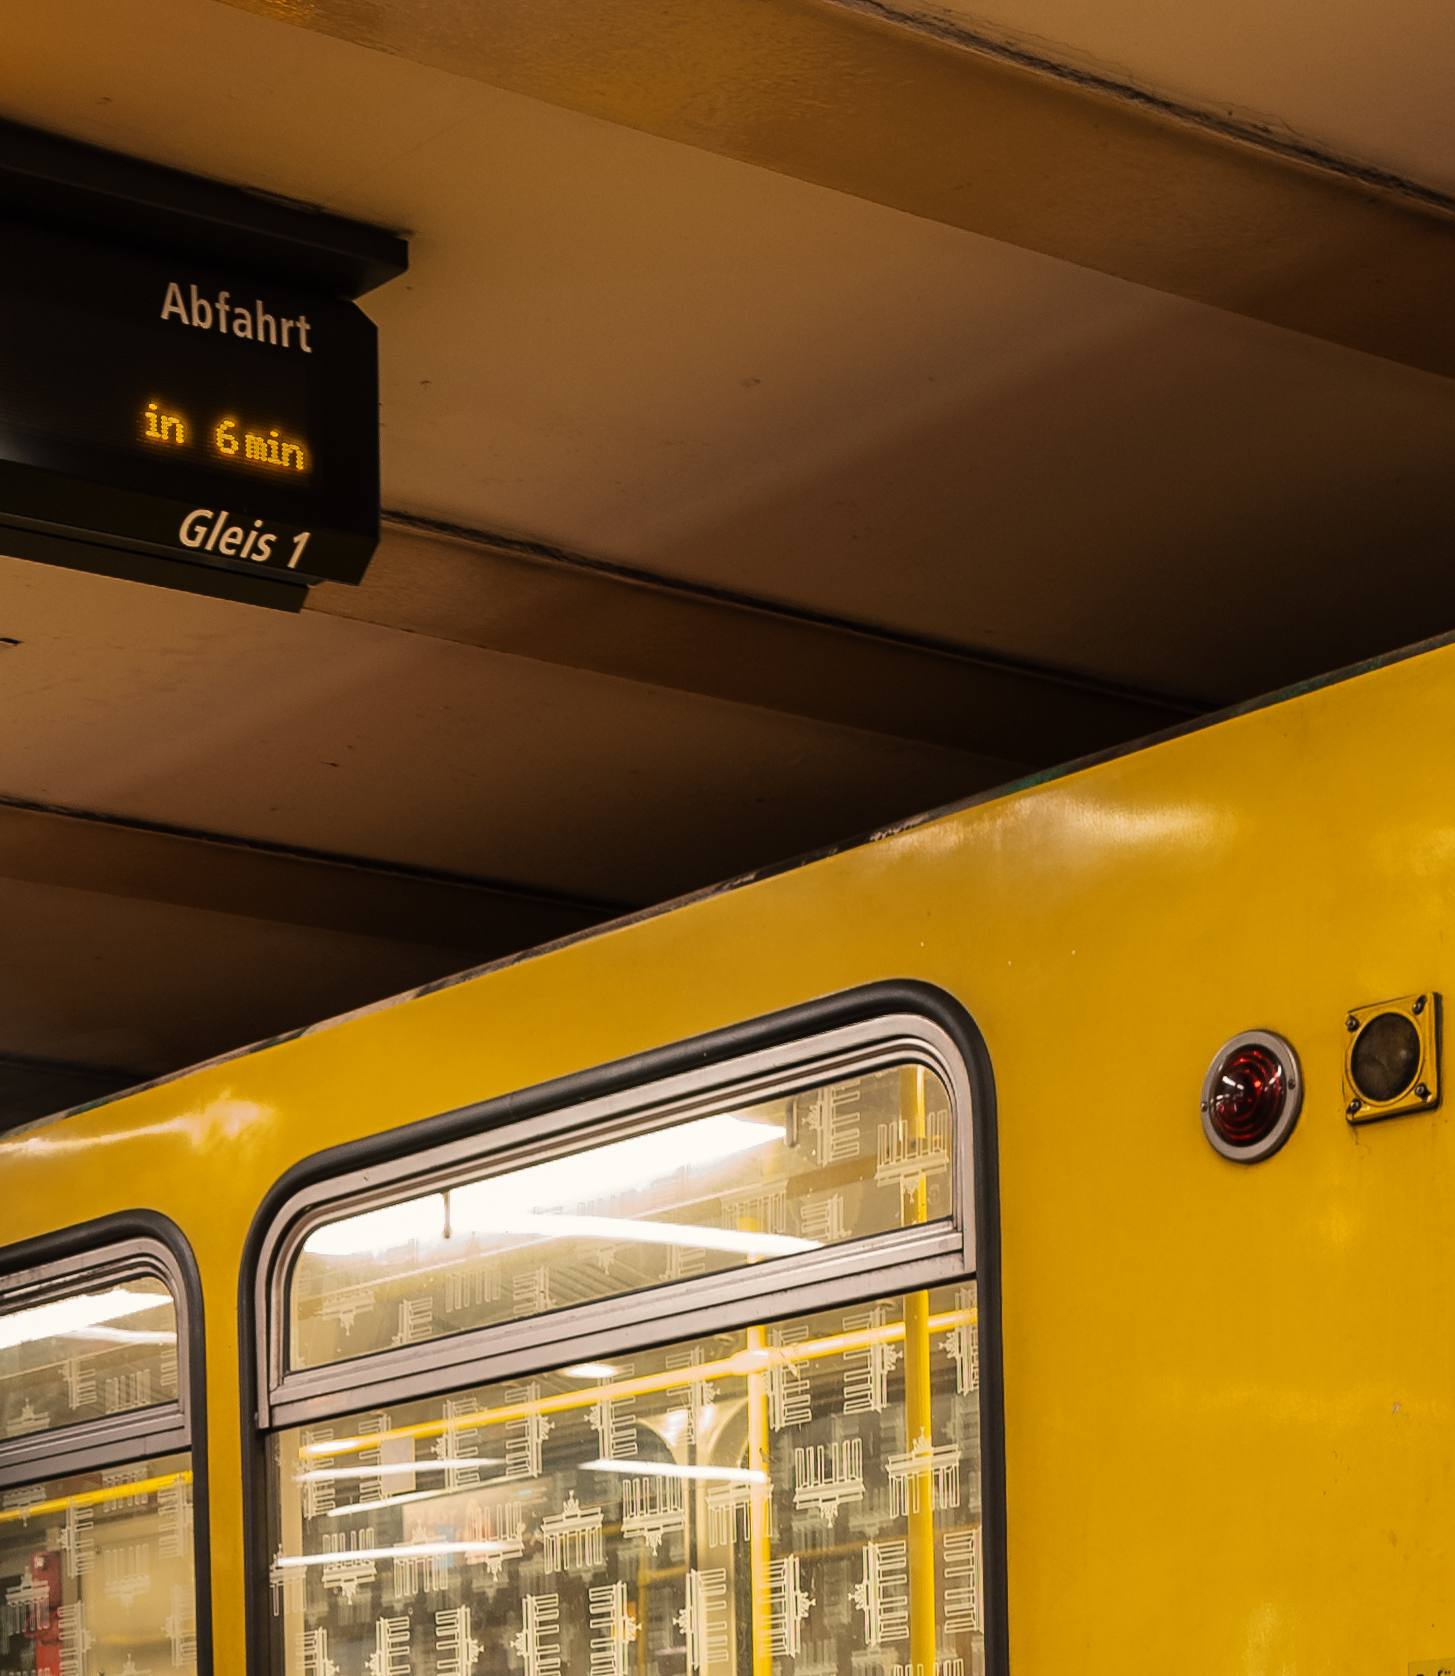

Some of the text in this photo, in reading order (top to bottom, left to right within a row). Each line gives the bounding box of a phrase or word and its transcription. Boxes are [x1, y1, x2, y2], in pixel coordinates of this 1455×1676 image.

[161, 282, 312, 353] Abfahrt
[145, 403, 184, 444] in
[179, 509, 311, 569] Gleis 1
